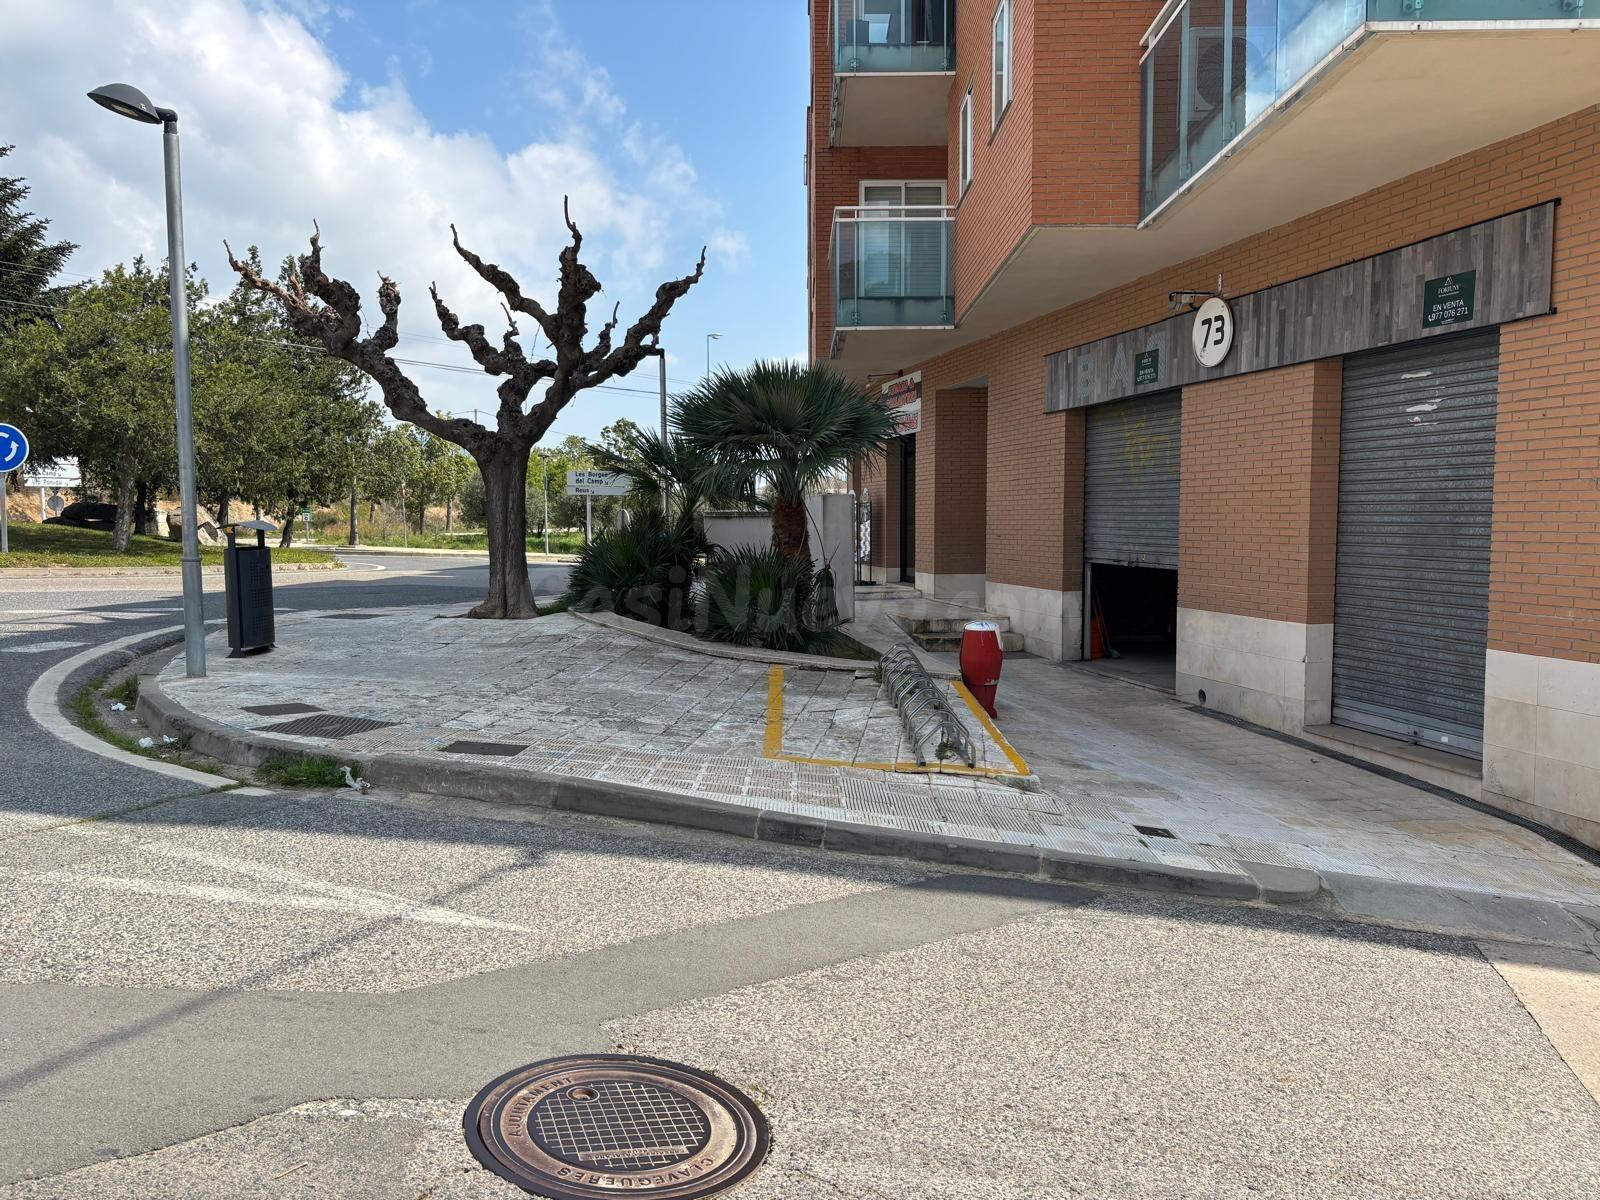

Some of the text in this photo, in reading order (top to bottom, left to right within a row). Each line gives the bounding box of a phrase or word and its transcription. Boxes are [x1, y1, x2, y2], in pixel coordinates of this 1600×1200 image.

[1431, 307, 1468, 320] 977 076 271
[1443, 299, 1464, 309] VENTA
[1202, 315, 1225, 348] 73
[508, 1077, 573, 1137] AJUNTAMENT
[557, 1158, 714, 1189] CLAVEGUERES
